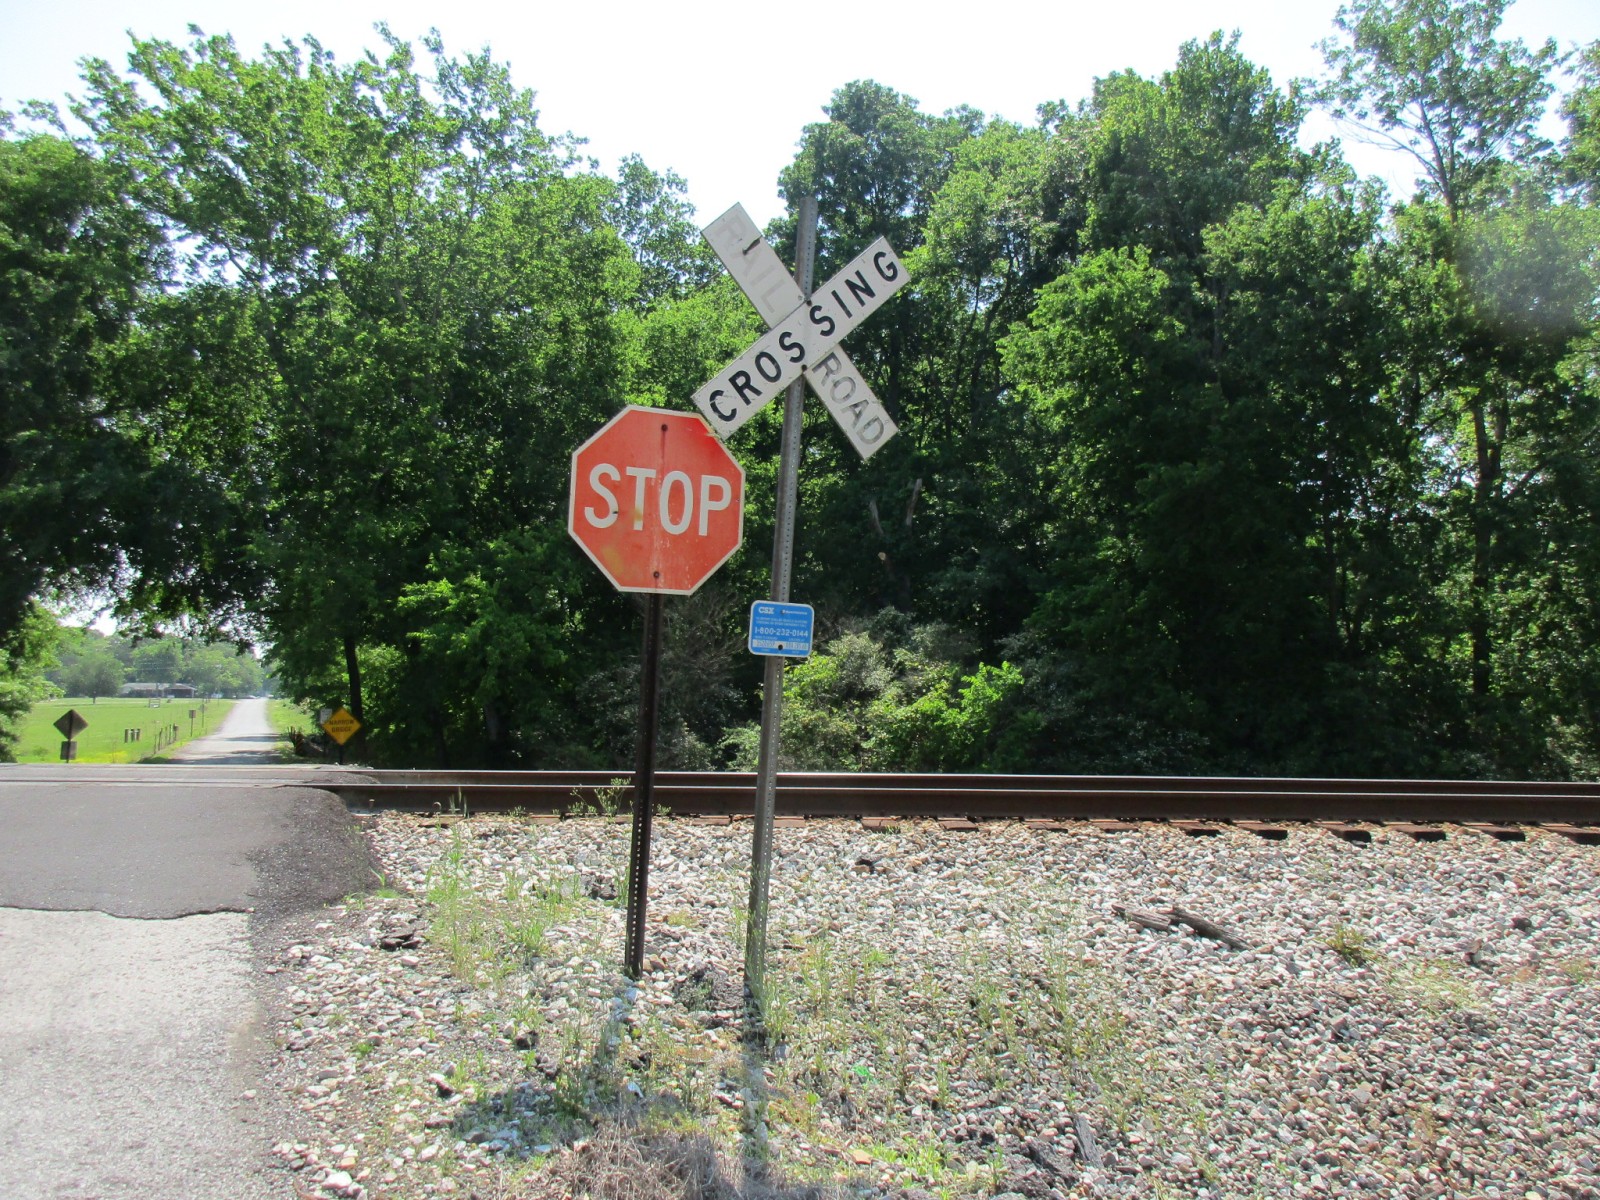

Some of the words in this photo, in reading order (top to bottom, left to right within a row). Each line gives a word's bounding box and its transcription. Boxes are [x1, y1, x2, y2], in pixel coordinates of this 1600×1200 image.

[709, 251, 899, 422] CROSSING
[715, 214, 786, 314] RAIL
[812, 351, 885, 446] ROAD
[584, 463, 732, 537] STOP
[754, 626, 808, 638] 1-800-232-0144
[758, 606, 775, 615] CSX
